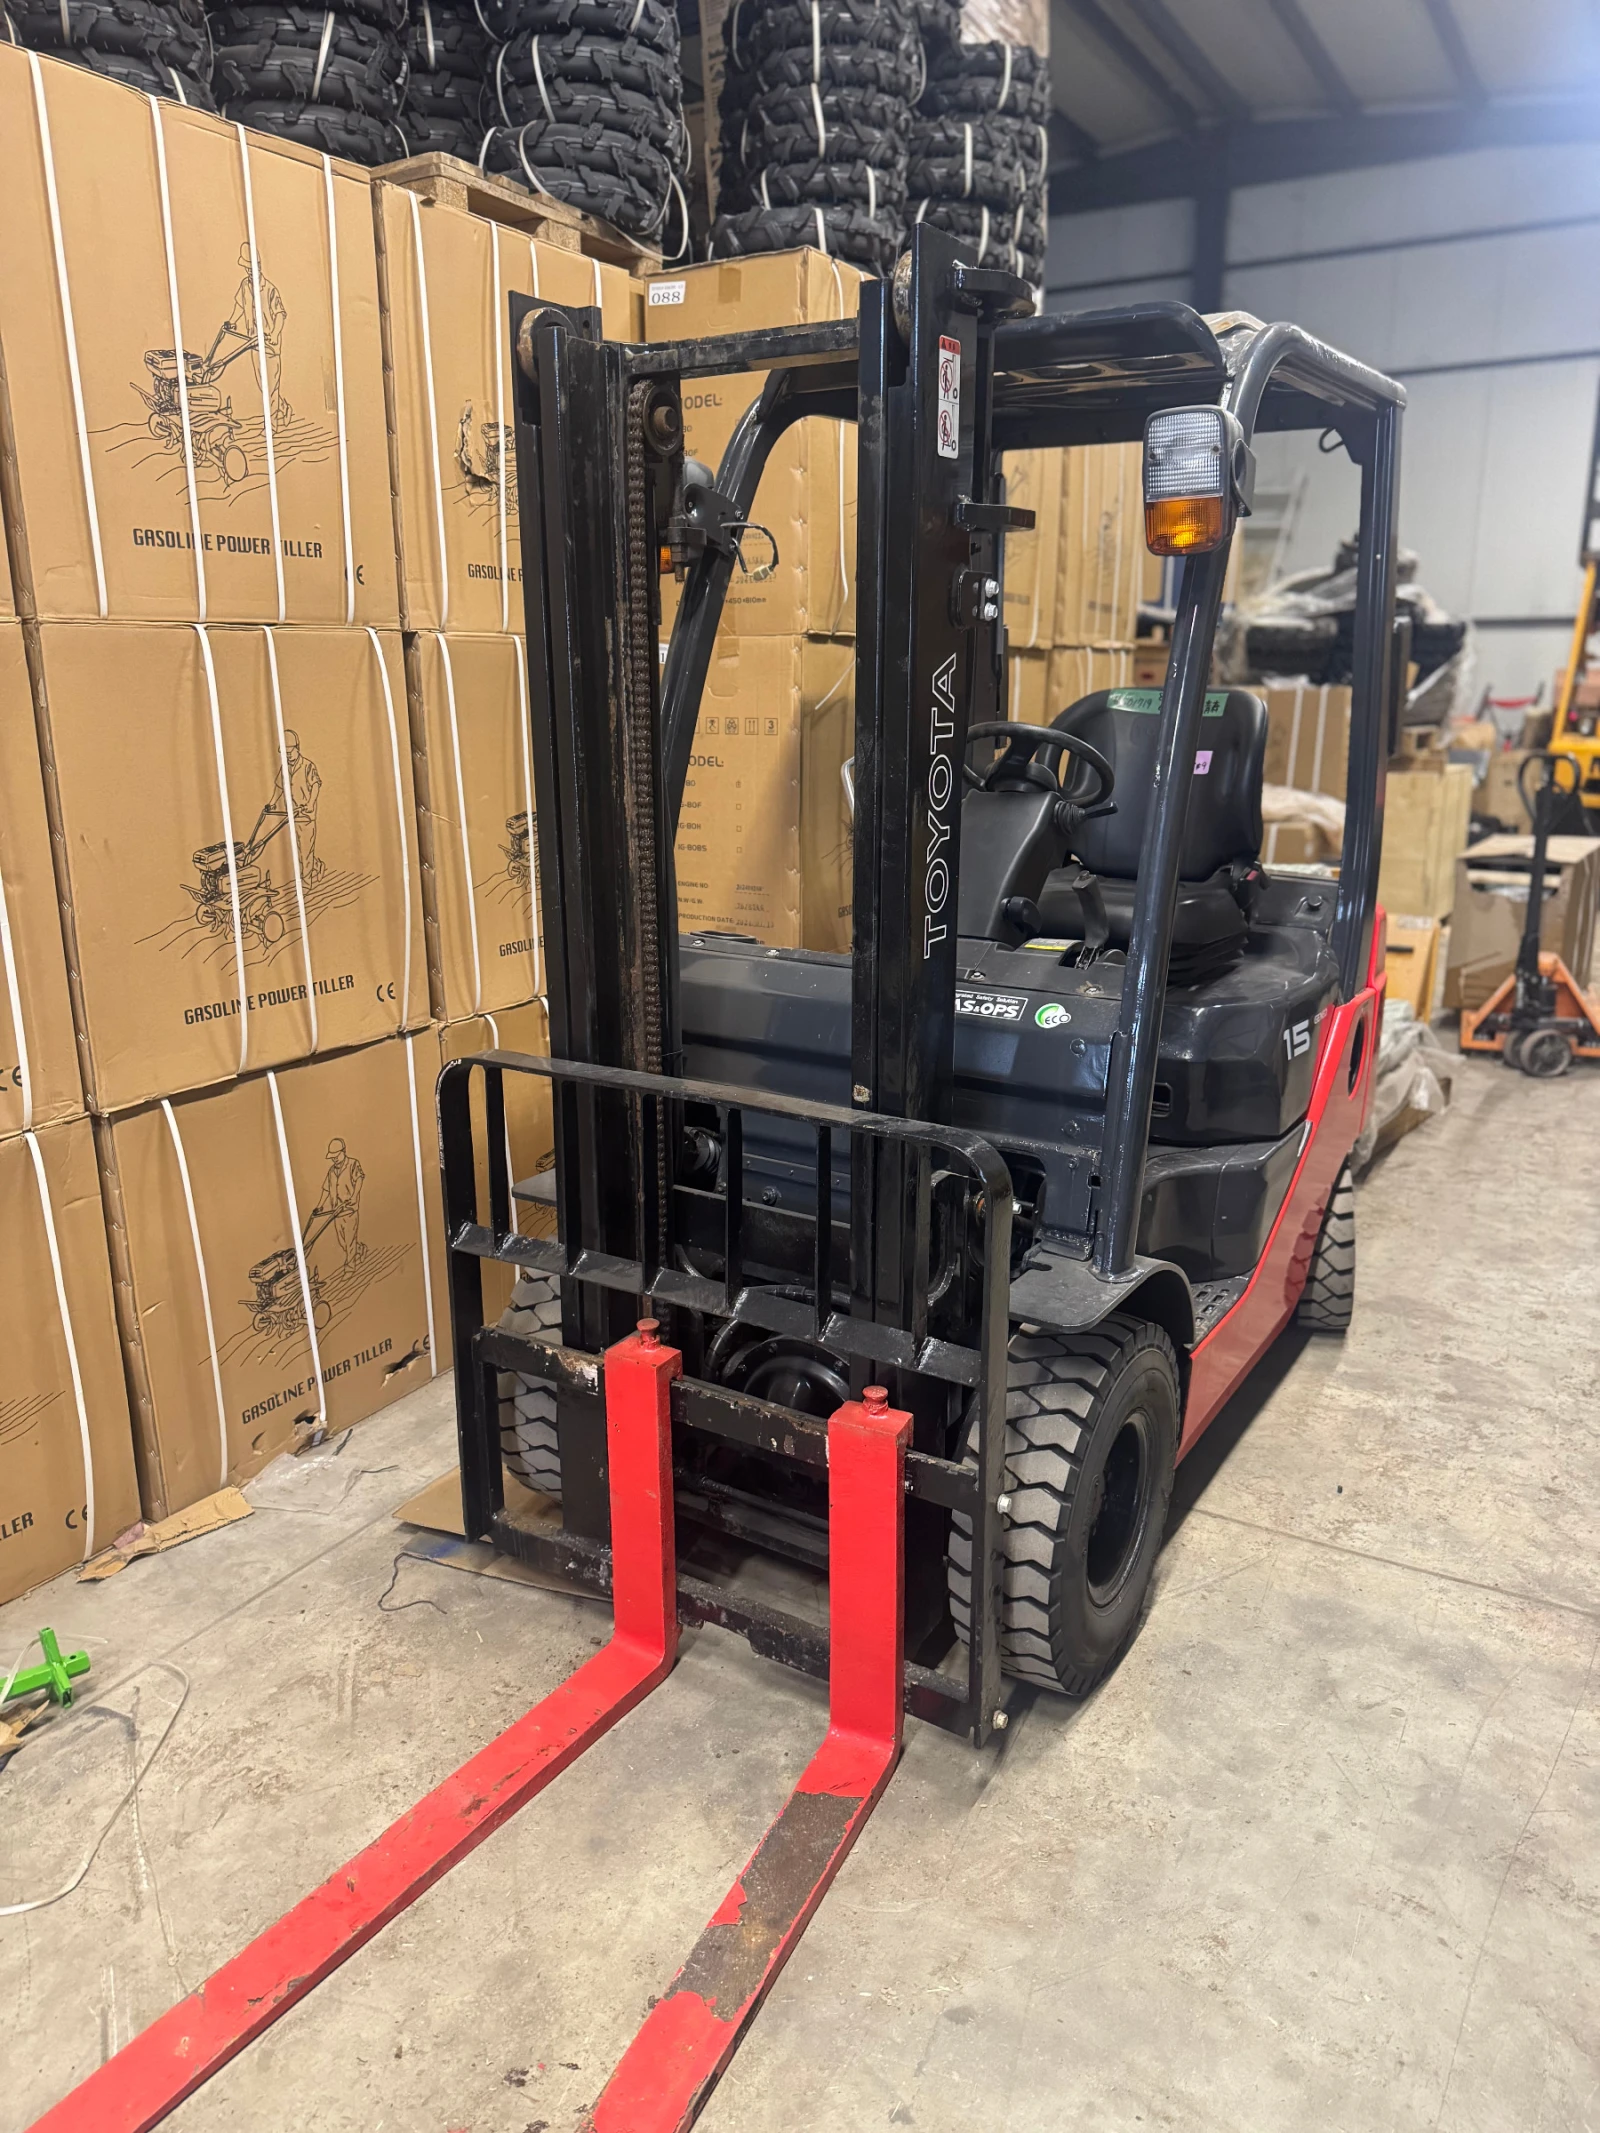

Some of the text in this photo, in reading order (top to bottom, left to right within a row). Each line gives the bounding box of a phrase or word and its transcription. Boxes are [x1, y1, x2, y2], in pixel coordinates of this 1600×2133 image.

[651, 291, 681, 305] 088
[681, 393, 723, 410] ODEL:
[216, 534, 271, 555] POWER
[280, 539, 323, 558] ILLER
[688, 756, 724, 768] ODEL:
[923, 652, 957, 960] TOYOTA
[678, 912, 716, 922] PRODUCTION
[258, 984, 307, 1009] POWER
[312, 974, 355, 997] TILLER
[975, 994, 994, 1002] Safety
[996, 996, 1019, 1005] Solution
[1044, 1013, 1072, 1025] ECO
[1283, 1019, 1311, 1061] 15
[241, 1337, 393, 1425] GASOLINE PWER TILLER
[0, 1511, 35, 1541] LER
